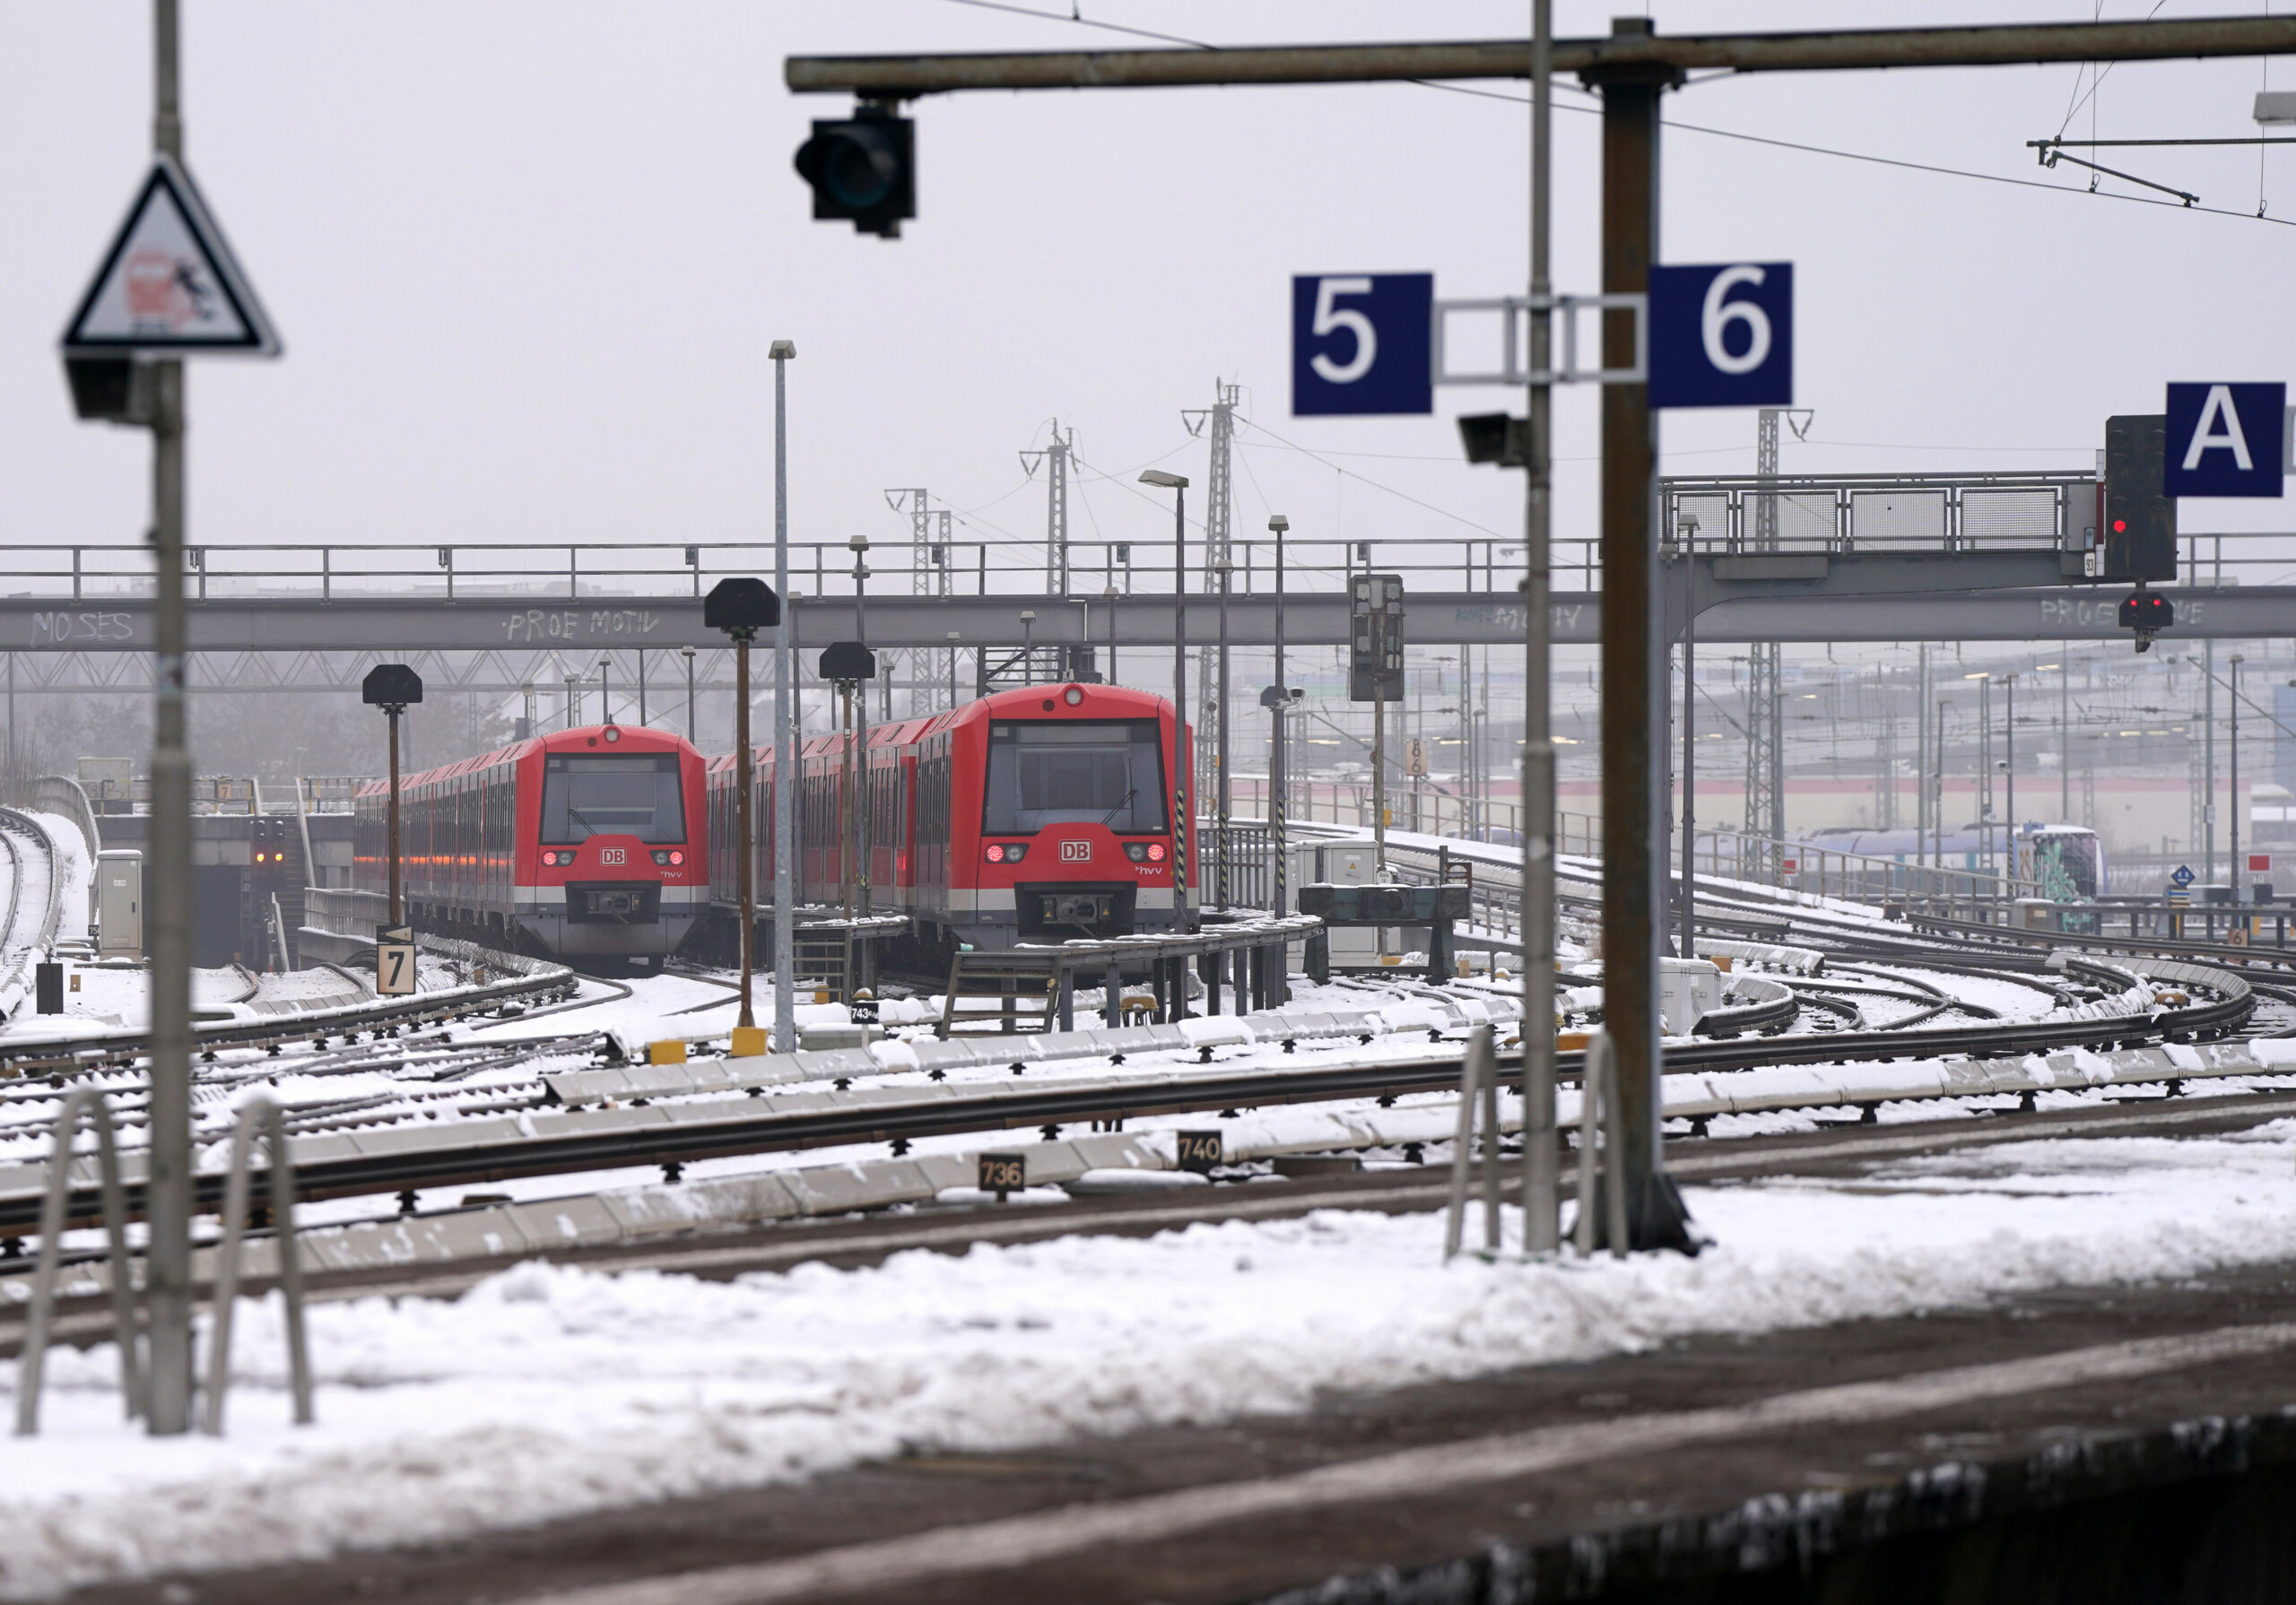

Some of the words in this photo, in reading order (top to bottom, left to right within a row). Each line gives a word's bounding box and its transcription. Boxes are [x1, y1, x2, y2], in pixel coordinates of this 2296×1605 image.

[1310, 276, 1377, 384] 5
[1700, 265, 1772, 375] 6
[2181, 385, 2254, 470] A
[2086, 559, 2094, 572] 93
[30, 612, 133, 647] MOSES
[603, 850, 624, 863] DB
[1062, 843, 1090, 860] DB
[2233, 932, 2242, 945] 6
[388, 951, 404, 986] 7
[1179, 1137, 1221, 1160] 740
[983, 1161, 1022, 1186] 736
